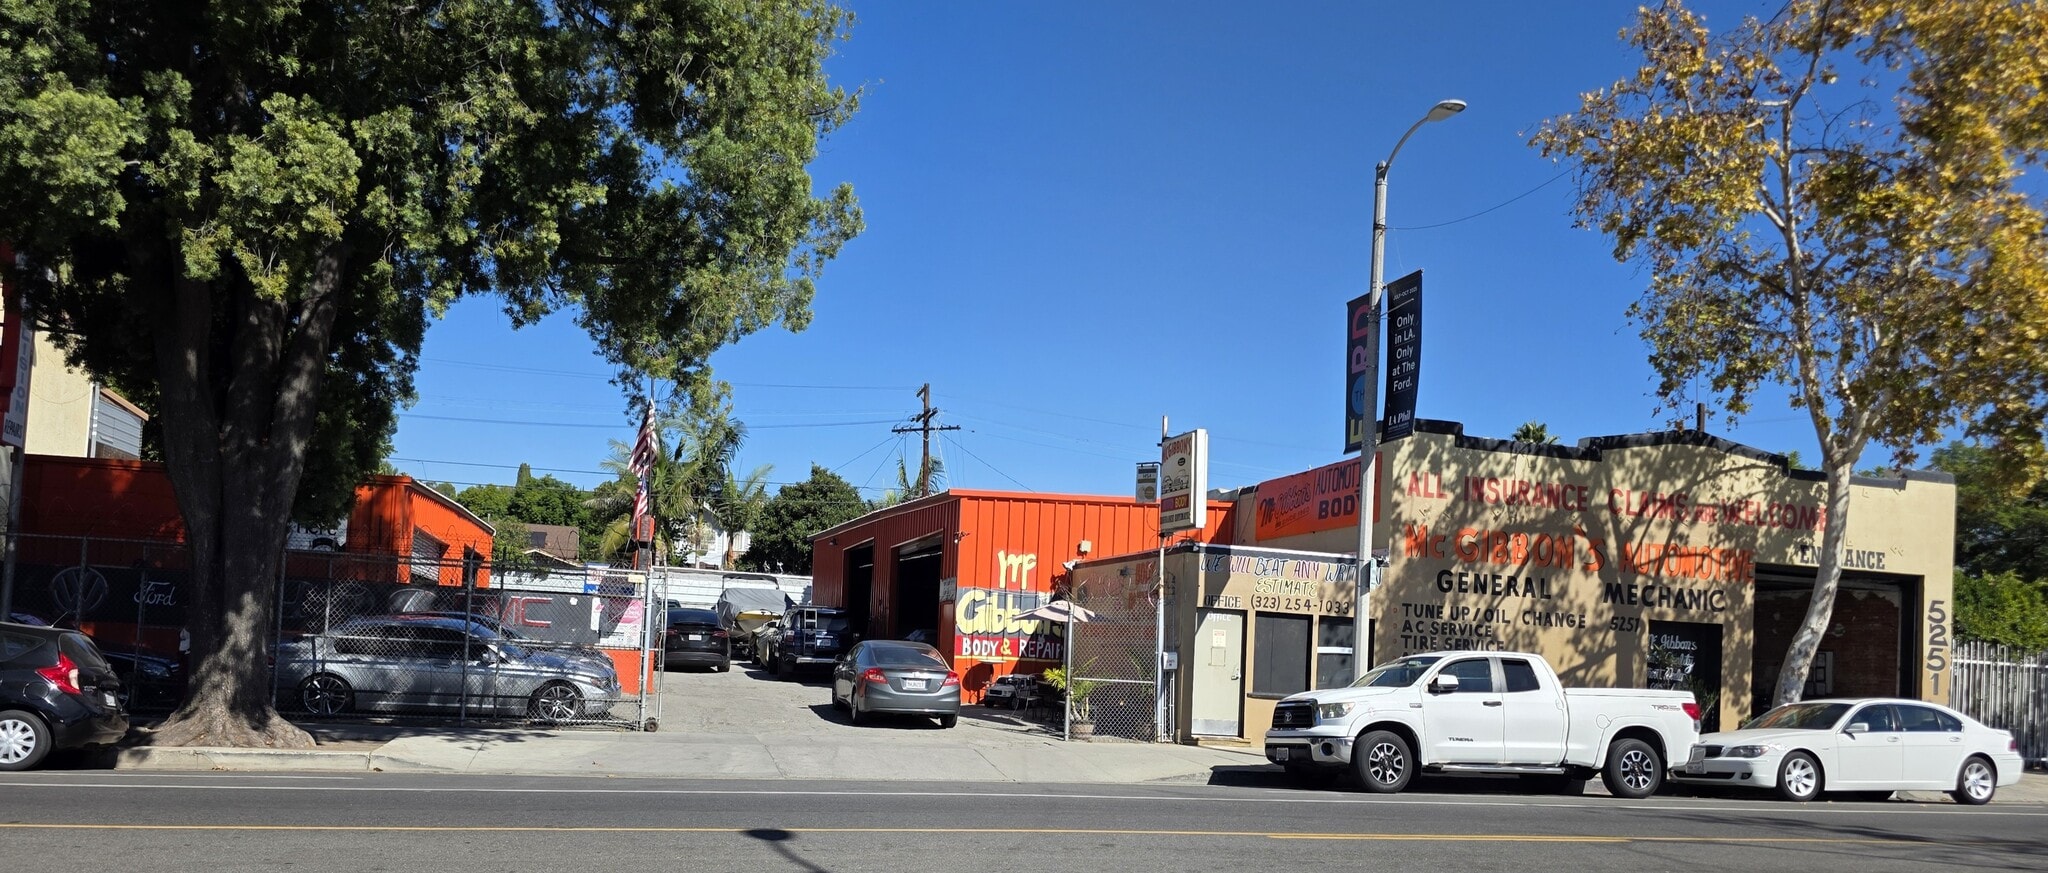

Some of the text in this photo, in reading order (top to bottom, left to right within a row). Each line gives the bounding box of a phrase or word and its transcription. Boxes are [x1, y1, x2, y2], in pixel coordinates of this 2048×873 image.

[1396, 313, 1415, 327] Only
[1395, 328, 1416, 345] in LA.
[1396, 345, 1414, 359] Only
[1392, 360, 1415, 376] at The
[1393, 376, 1413, 392] Ford.
[1397, 409, 1411, 424] Phil
[1407, 471, 1828, 532] ALL INSURANCE CLAIMS ARE WELCOME
[1200, 554, 1225, 573] WE
[1228, 555, 1251, 574] WILL
[1254, 557, 1290, 577] BEAT
[1293, 559, 1320, 579] ANY
[1619, 541, 1756, 584] AUTOMOTIVE
[1800, 544, 1886, 570] ENANCE
[134, 580, 177, 606] Ford
[1255, 577, 1318, 598] ESTIMATE
[1436, 569, 1726, 613] GENERAL MECHANIC
[1204, 594, 1350, 615] OFFICE (323) 254-1033
[1402, 603, 1444, 620] TUNE
[1522, 611, 1586, 629] CHANGE
[1609, 616, 1641, 633] 5251
[1402, 620, 1493, 638] AC SERVICE
[962, 637, 999, 657] BODY
[1000, 638, 1012, 656] &
[1401, 634, 1505, 652] TIRE SERVICE
[1925, 599, 1949, 696] 5251
